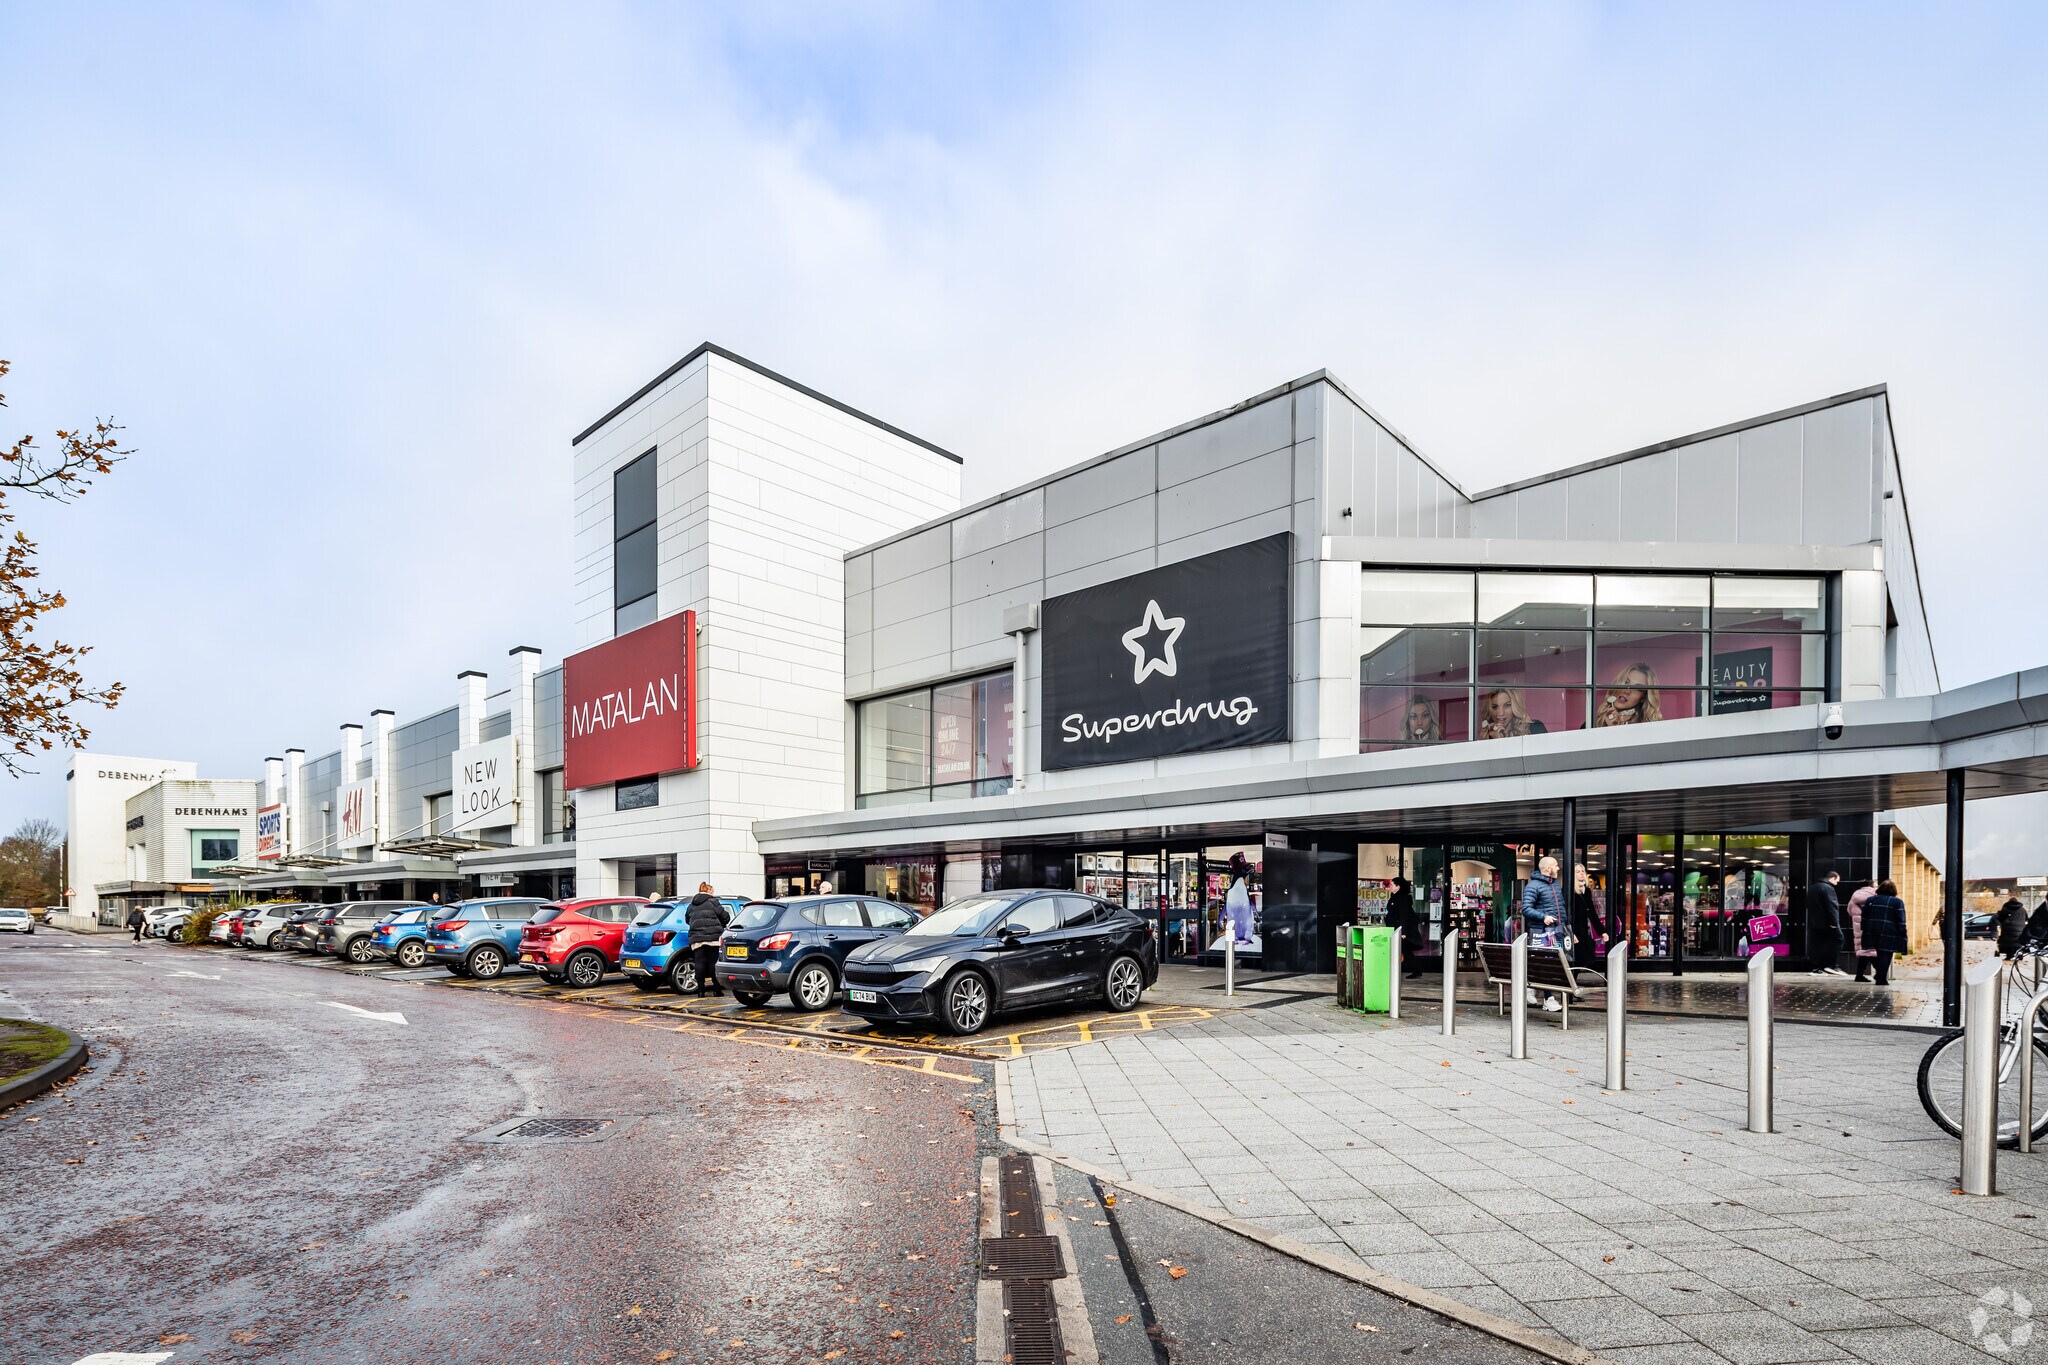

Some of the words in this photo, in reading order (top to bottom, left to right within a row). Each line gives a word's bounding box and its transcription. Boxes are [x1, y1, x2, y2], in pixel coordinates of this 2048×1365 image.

[1712, 662, 1767, 683] EAUTY
[571, 673, 678, 739] MATALAN
[940, 714, 957, 729] OPEN
[1061, 696, 1259, 744] Superdrug
[938, 727, 960, 743] ONLINE
[464, 757, 498, 786] NEW
[175, 807, 248, 816] DEBENHAMS
[461, 786, 501, 814] LOOK
[259, 812, 281, 837] SPORTS
